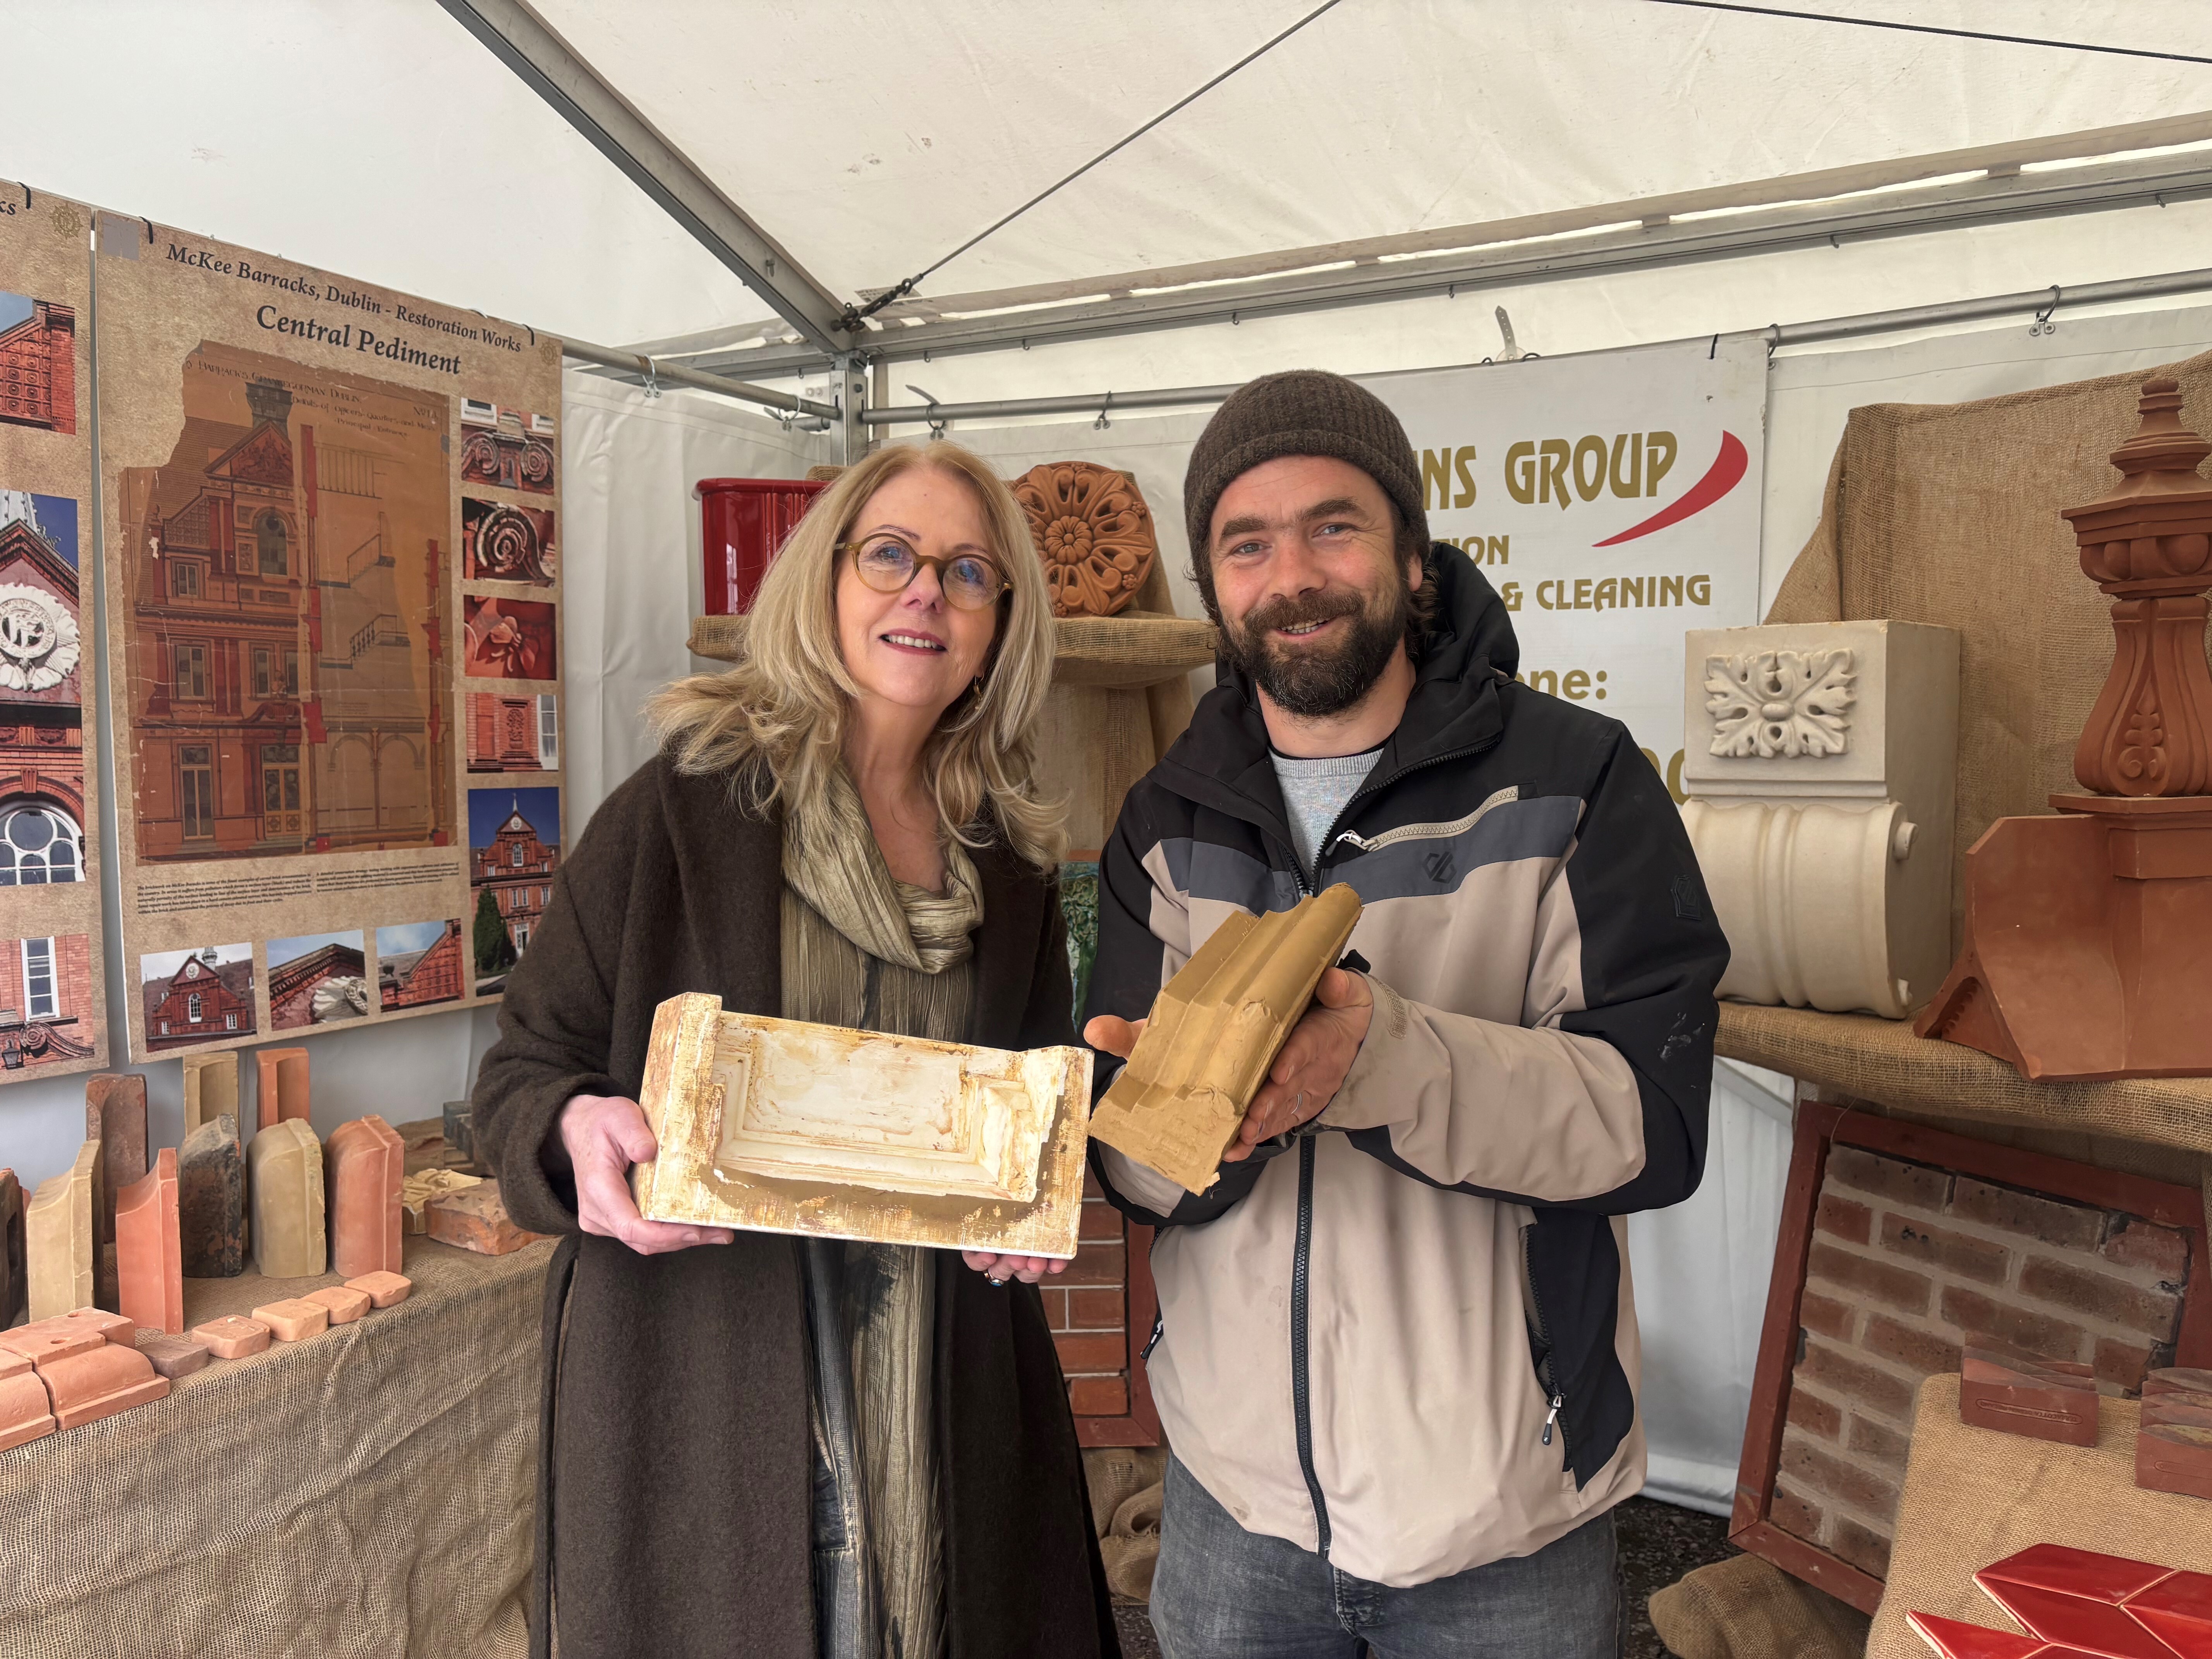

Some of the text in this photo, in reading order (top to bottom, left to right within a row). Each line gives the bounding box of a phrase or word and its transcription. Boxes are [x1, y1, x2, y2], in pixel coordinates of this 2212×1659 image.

[165, 243, 232, 274] McKee
[236, 261, 320, 301] Barracks,
[325, 285, 381, 314] Dublin
[395, 304, 477, 340] Restoration
[481, 328, 521, 352] Works
[256, 305, 461, 374] Central Pediment
[1413, 431, 1678, 511] NS GROUP
[1434, 535, 1510, 566] ON
[1502, 574, 1711, 612] & CLEANING
[1515, 670, 1607, 700] ne:
